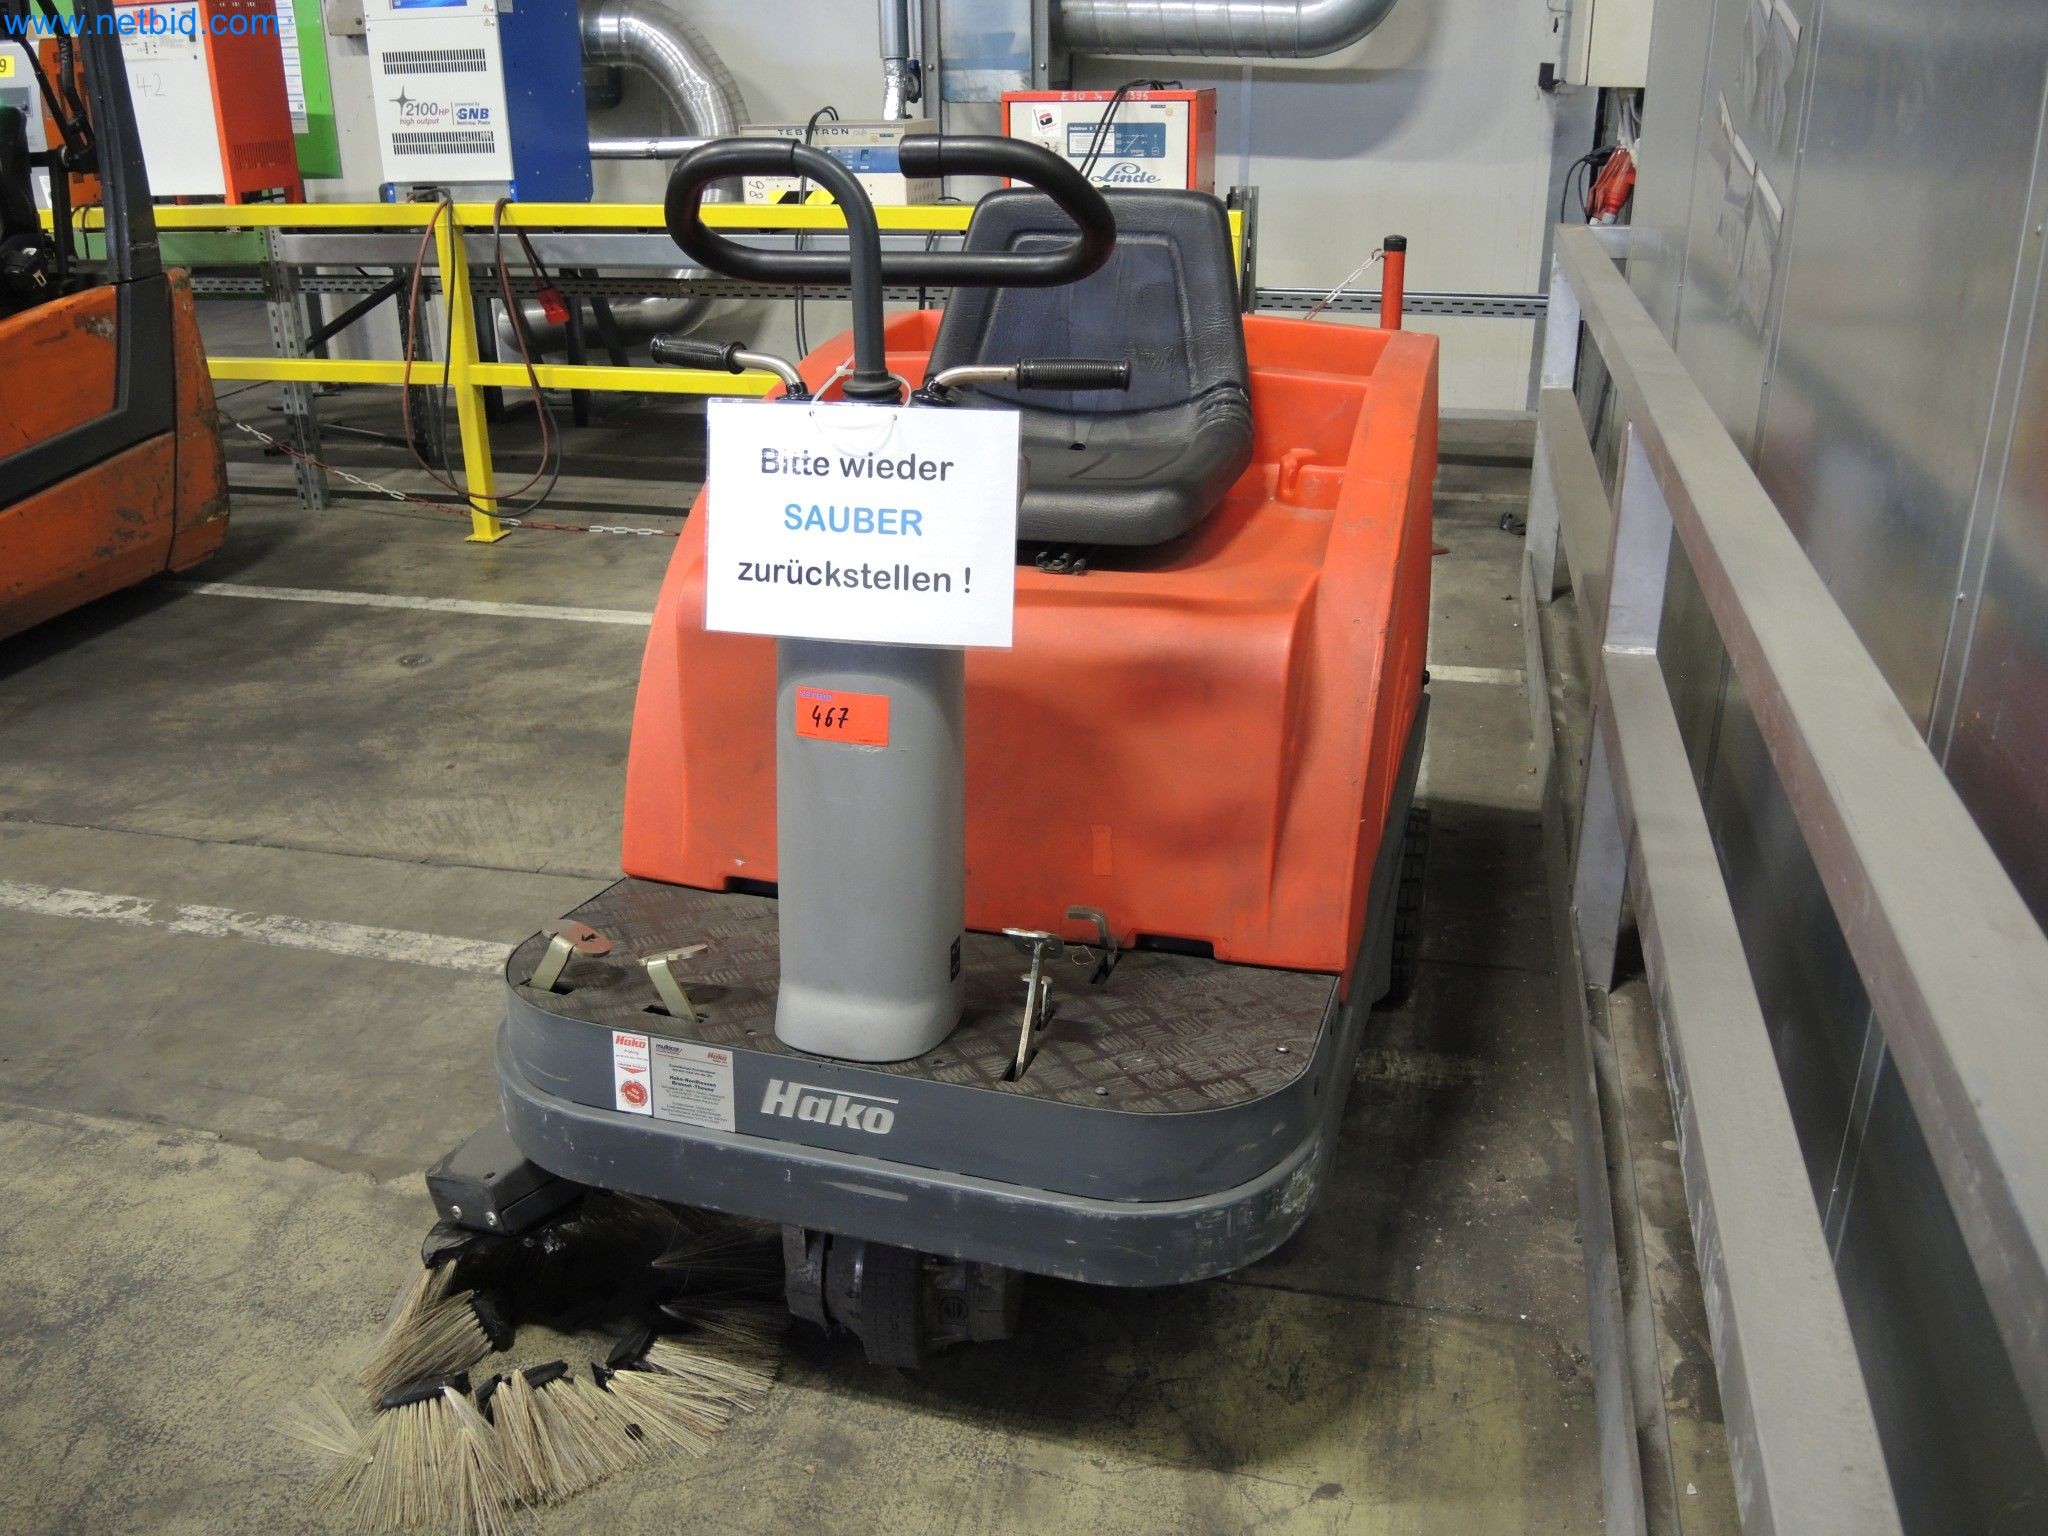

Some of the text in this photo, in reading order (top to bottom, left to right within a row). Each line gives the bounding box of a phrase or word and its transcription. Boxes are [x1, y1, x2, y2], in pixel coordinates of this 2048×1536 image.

[136, 73, 166, 97] 42
[406, 102, 438, 116] 2100
[456, 108, 490, 119] GNB
[400, 118, 415, 126] high
[778, 128, 849, 136] TEBTRON
[1091, 162, 1161, 183] Linde
[761, 448, 954, 481] Bitte wieder
[784, 503, 923, 536] SAUBER
[738, 558, 971, 593] zurückstellen !
[812, 705, 849, 728] 467
[615, 1035, 647, 1049] Hako
[708, 1052, 727, 1061] Hako
[760, 1078, 898, 1134] Hako
